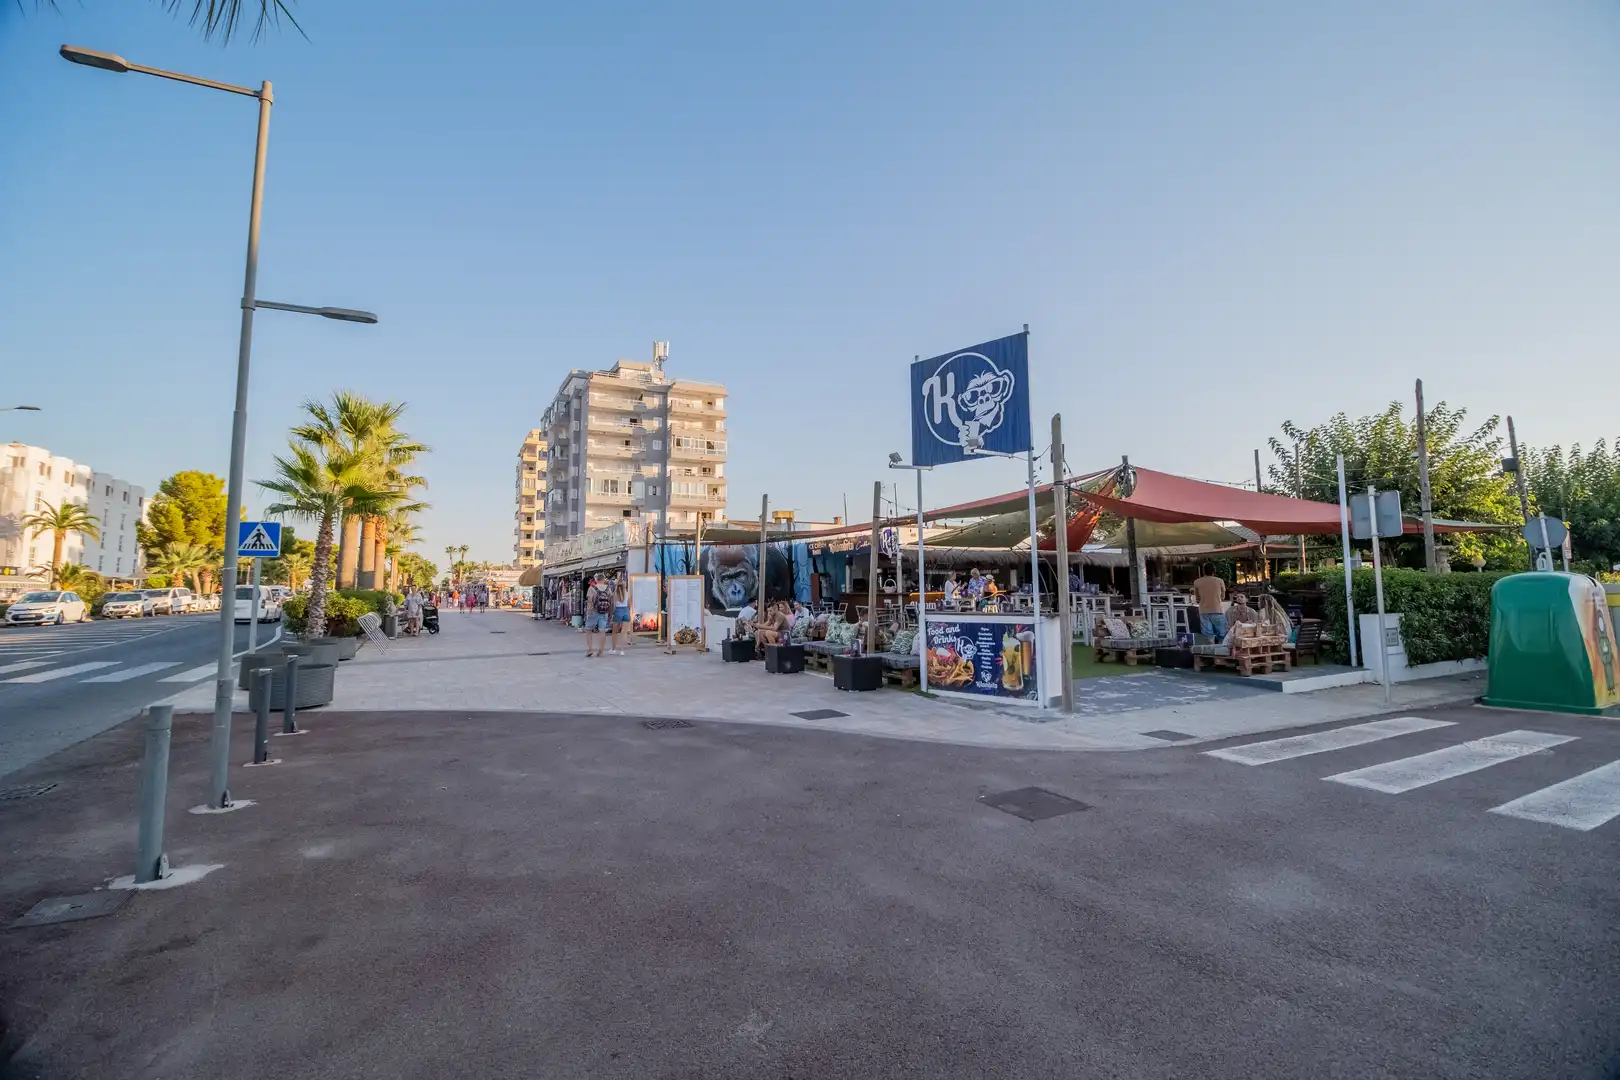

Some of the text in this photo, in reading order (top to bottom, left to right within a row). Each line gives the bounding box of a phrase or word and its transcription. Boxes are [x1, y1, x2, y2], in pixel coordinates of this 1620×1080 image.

[927, 624, 960, 636] Food and
[933, 635, 957, 644] Drinks
